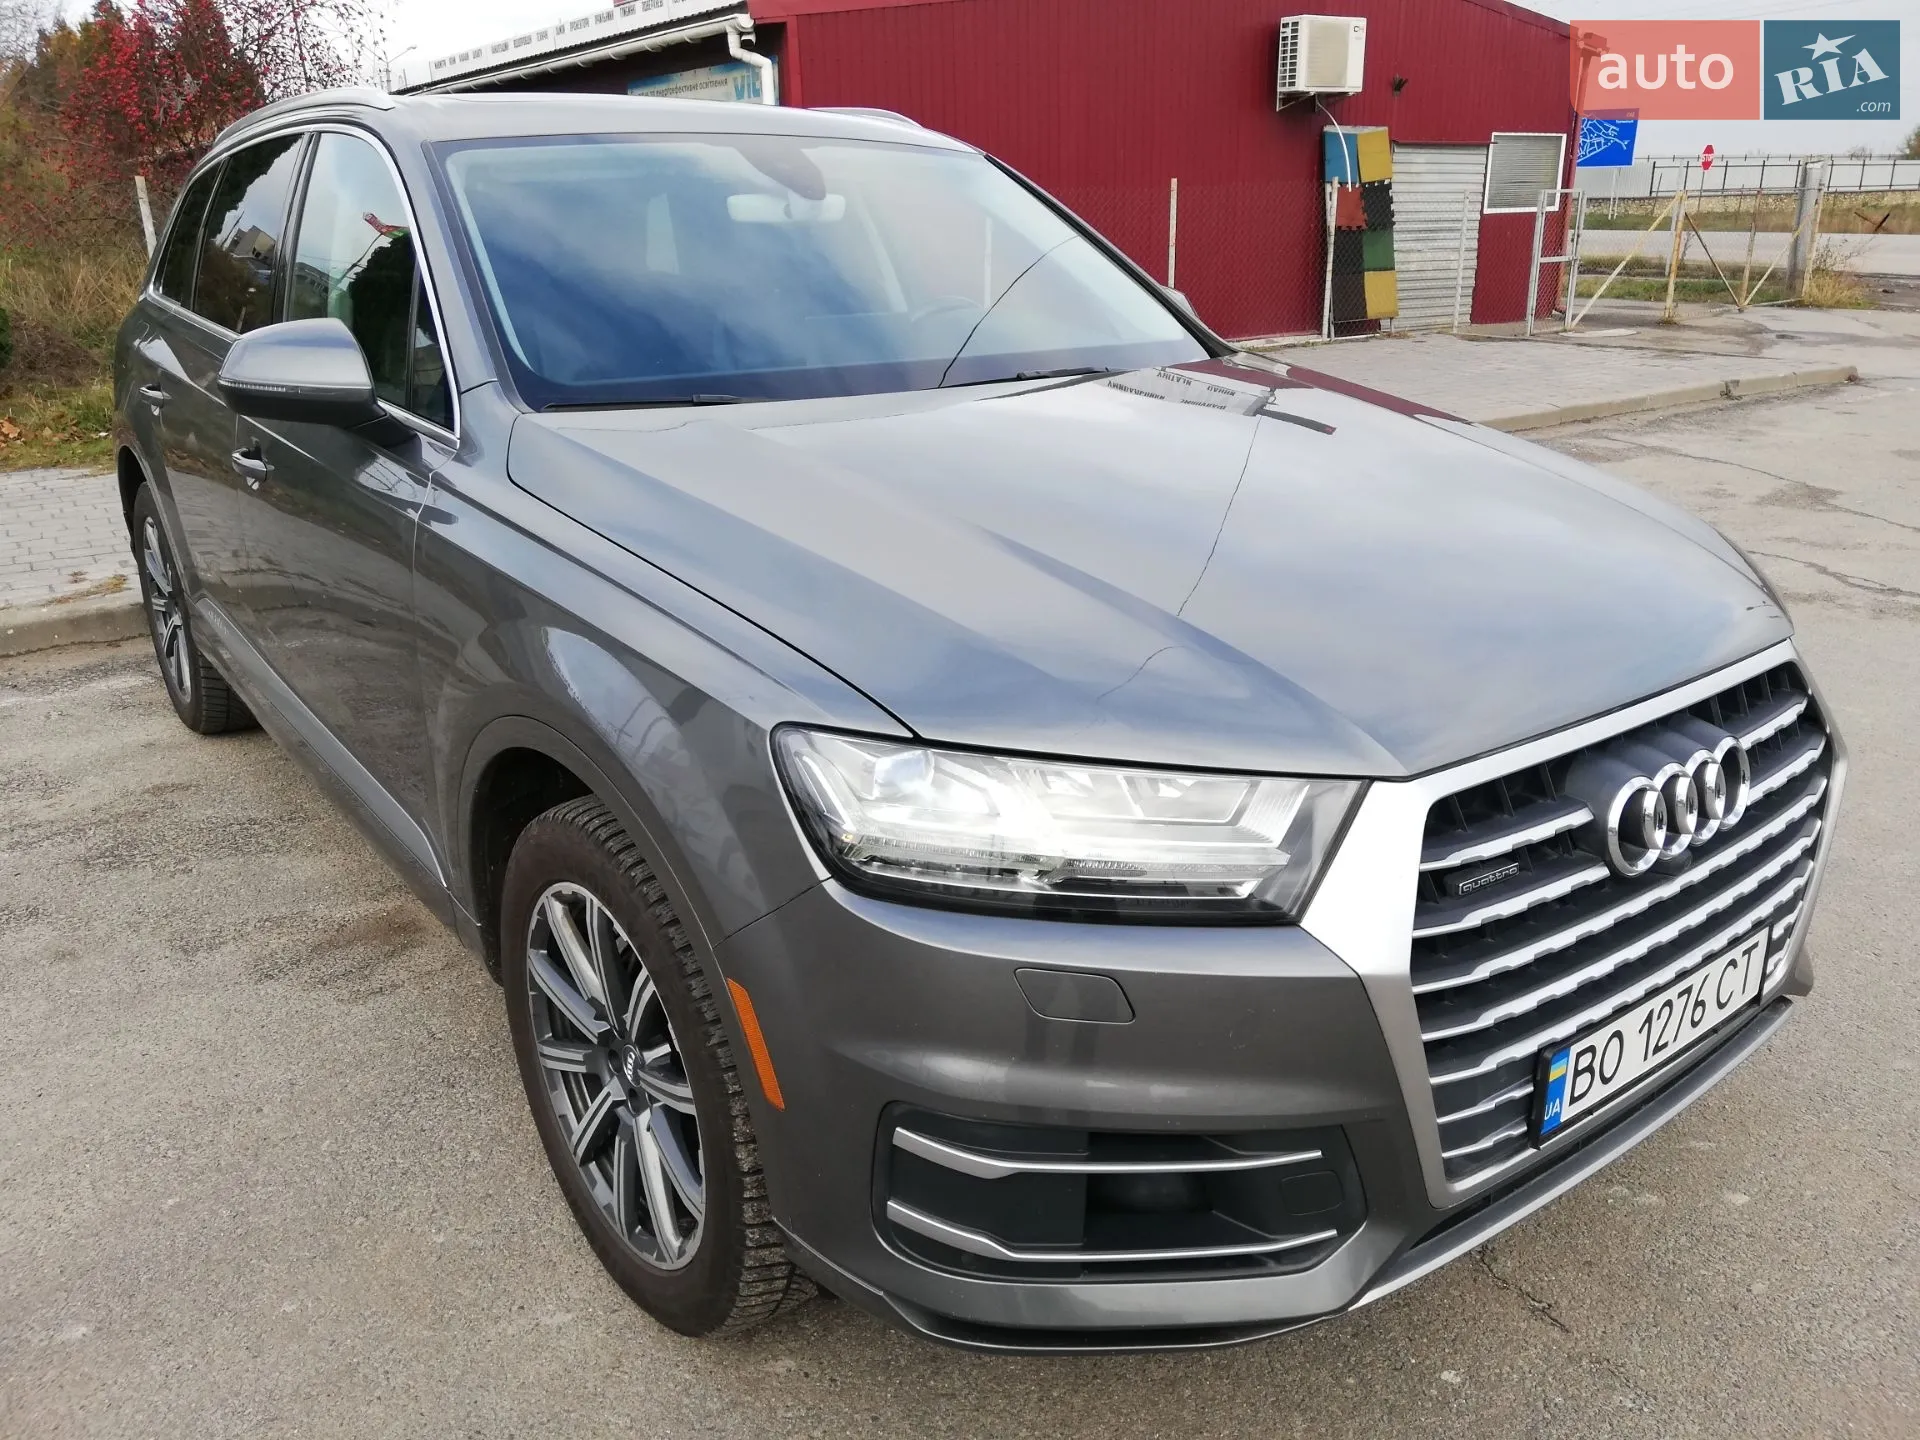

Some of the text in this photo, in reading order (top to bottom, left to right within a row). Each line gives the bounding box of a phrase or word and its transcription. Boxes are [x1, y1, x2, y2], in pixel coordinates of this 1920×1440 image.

[1701, 154, 1714, 163] STOP
[1462, 867, 1518, 892] quattro
[1568, 941, 1760, 1107] BO 1276 CT
[1544, 1104, 1561, 1120] UA
